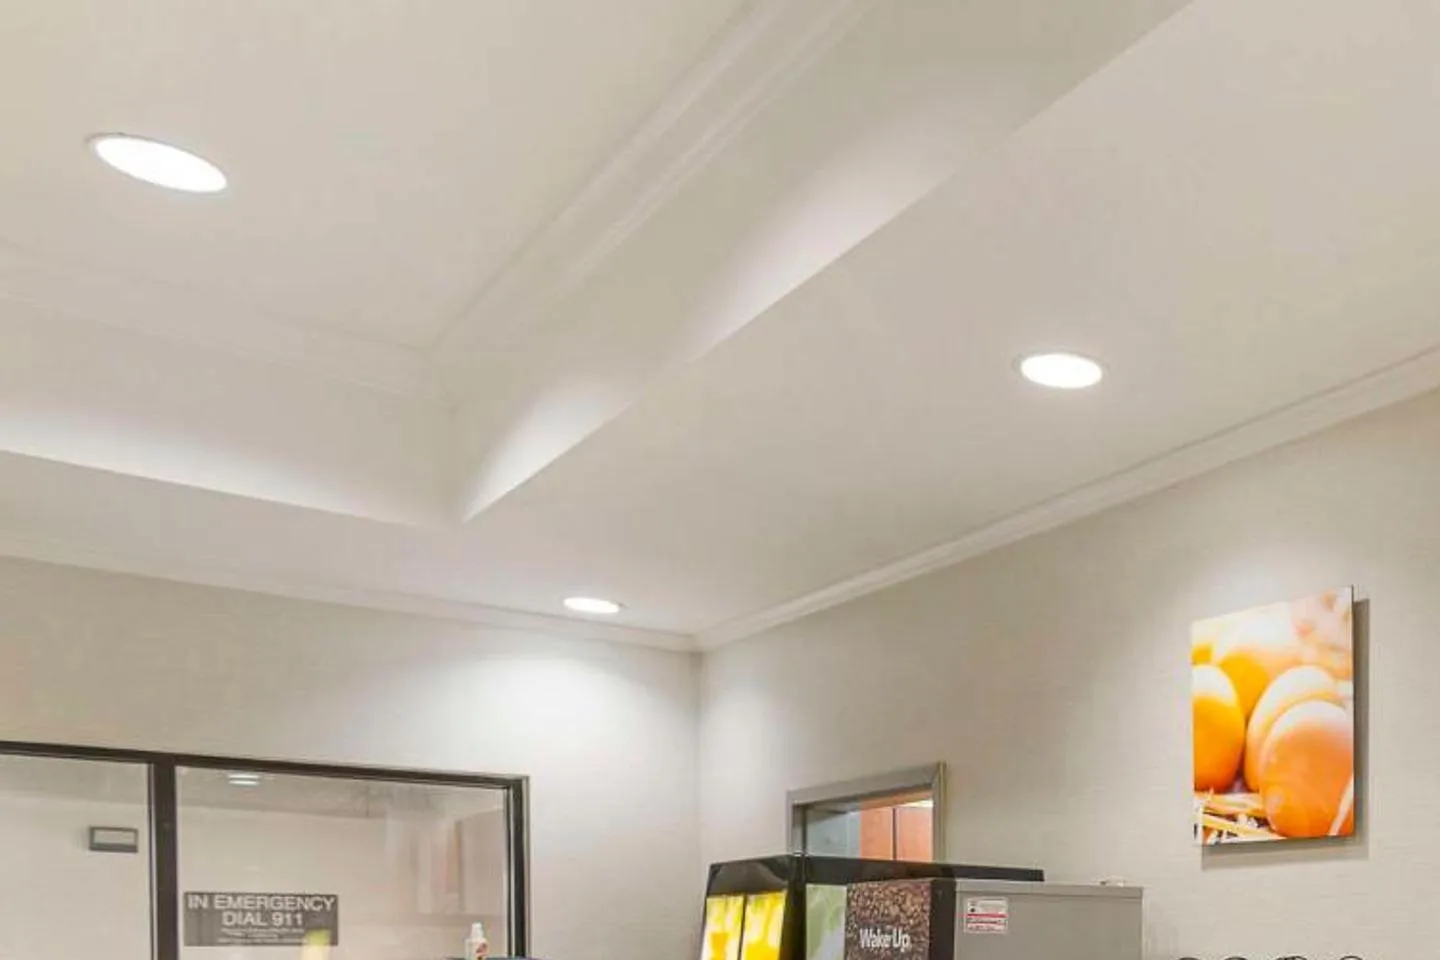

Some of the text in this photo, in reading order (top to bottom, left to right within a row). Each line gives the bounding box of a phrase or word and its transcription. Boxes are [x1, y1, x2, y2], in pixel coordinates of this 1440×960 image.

[187, 894, 335, 911] IN EMERGENCY
[222, 911, 303, 926] DIAL 911
